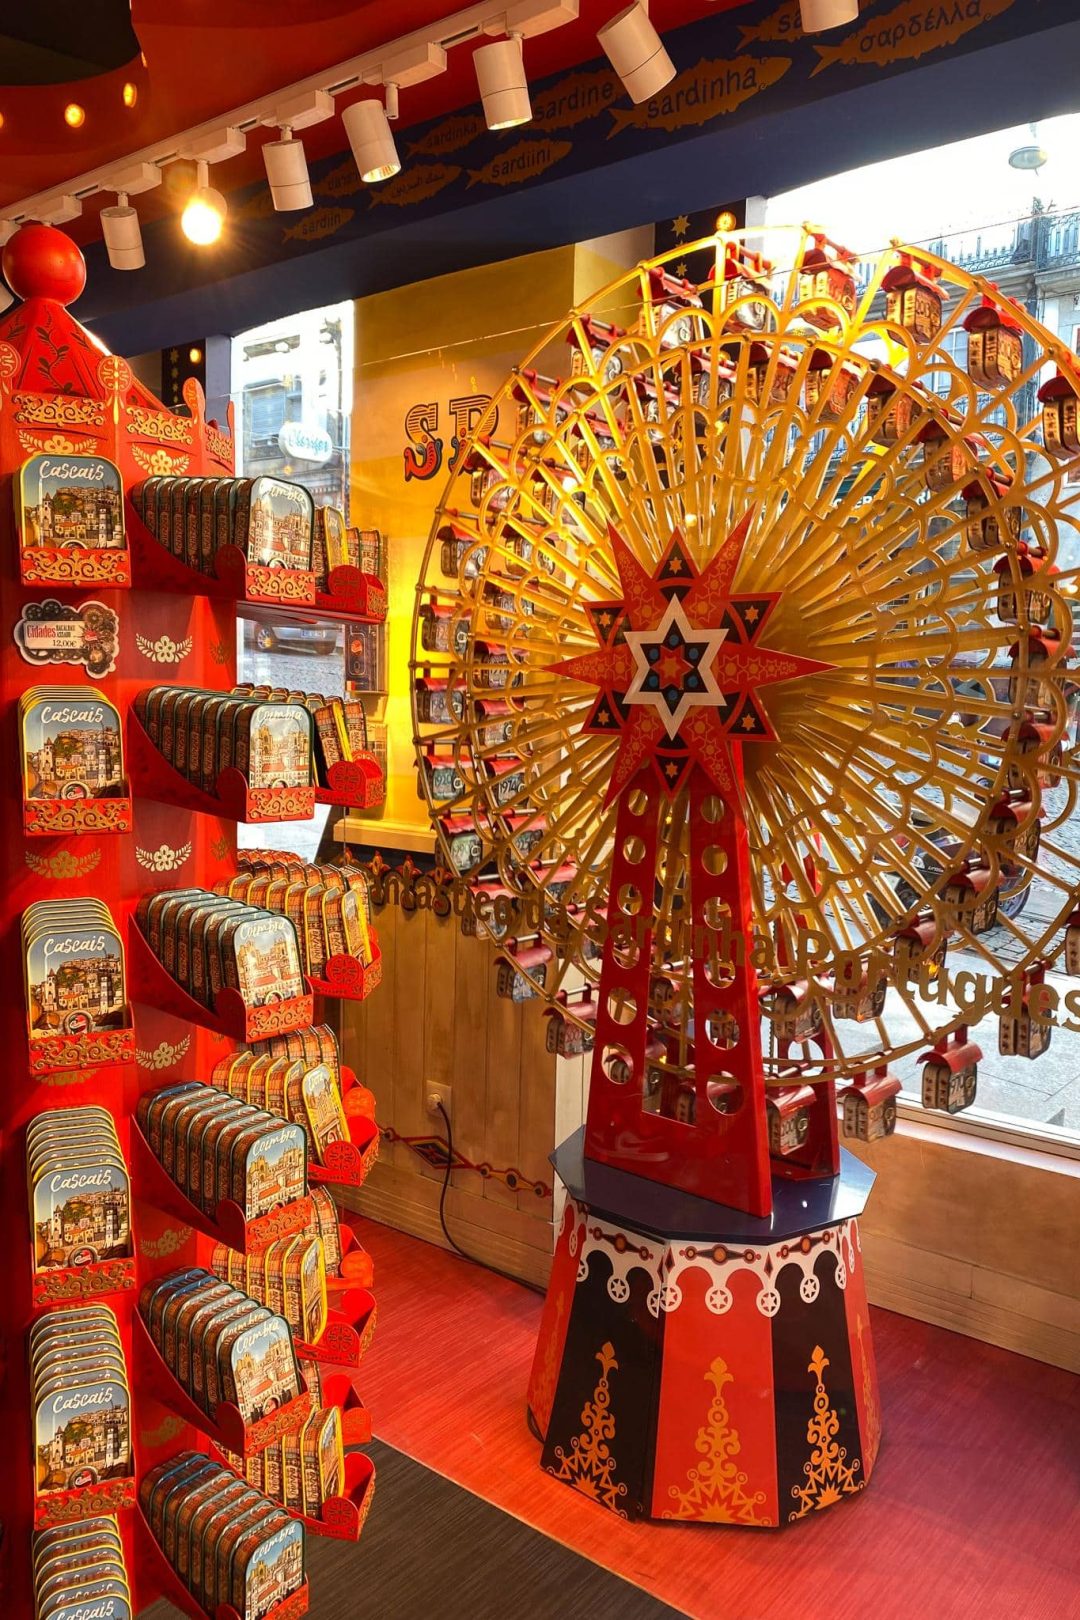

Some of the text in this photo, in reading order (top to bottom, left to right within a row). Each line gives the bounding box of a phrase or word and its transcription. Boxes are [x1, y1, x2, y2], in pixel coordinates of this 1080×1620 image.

[859, 3, 980, 53] σαρδέλλα
[533, 81, 615, 121] sardine
[647, 66, 757, 119] sardinha
[490, 147, 551, 178] sardiini
[39, 461, 105, 481] Cascais
[27, 624, 56, 638] Cidades
[41, 706, 104, 724] Cascais
[44, 936, 105, 956] Cascais
[253, 1128, 297, 1157] Coimbra
[51, 1169, 112, 1192] Cascais
[237, 1319, 279, 1353] Coimbra
[53, 1387, 113, 1413] Cascais
[252, 1523, 296, 1564] Coimbra
